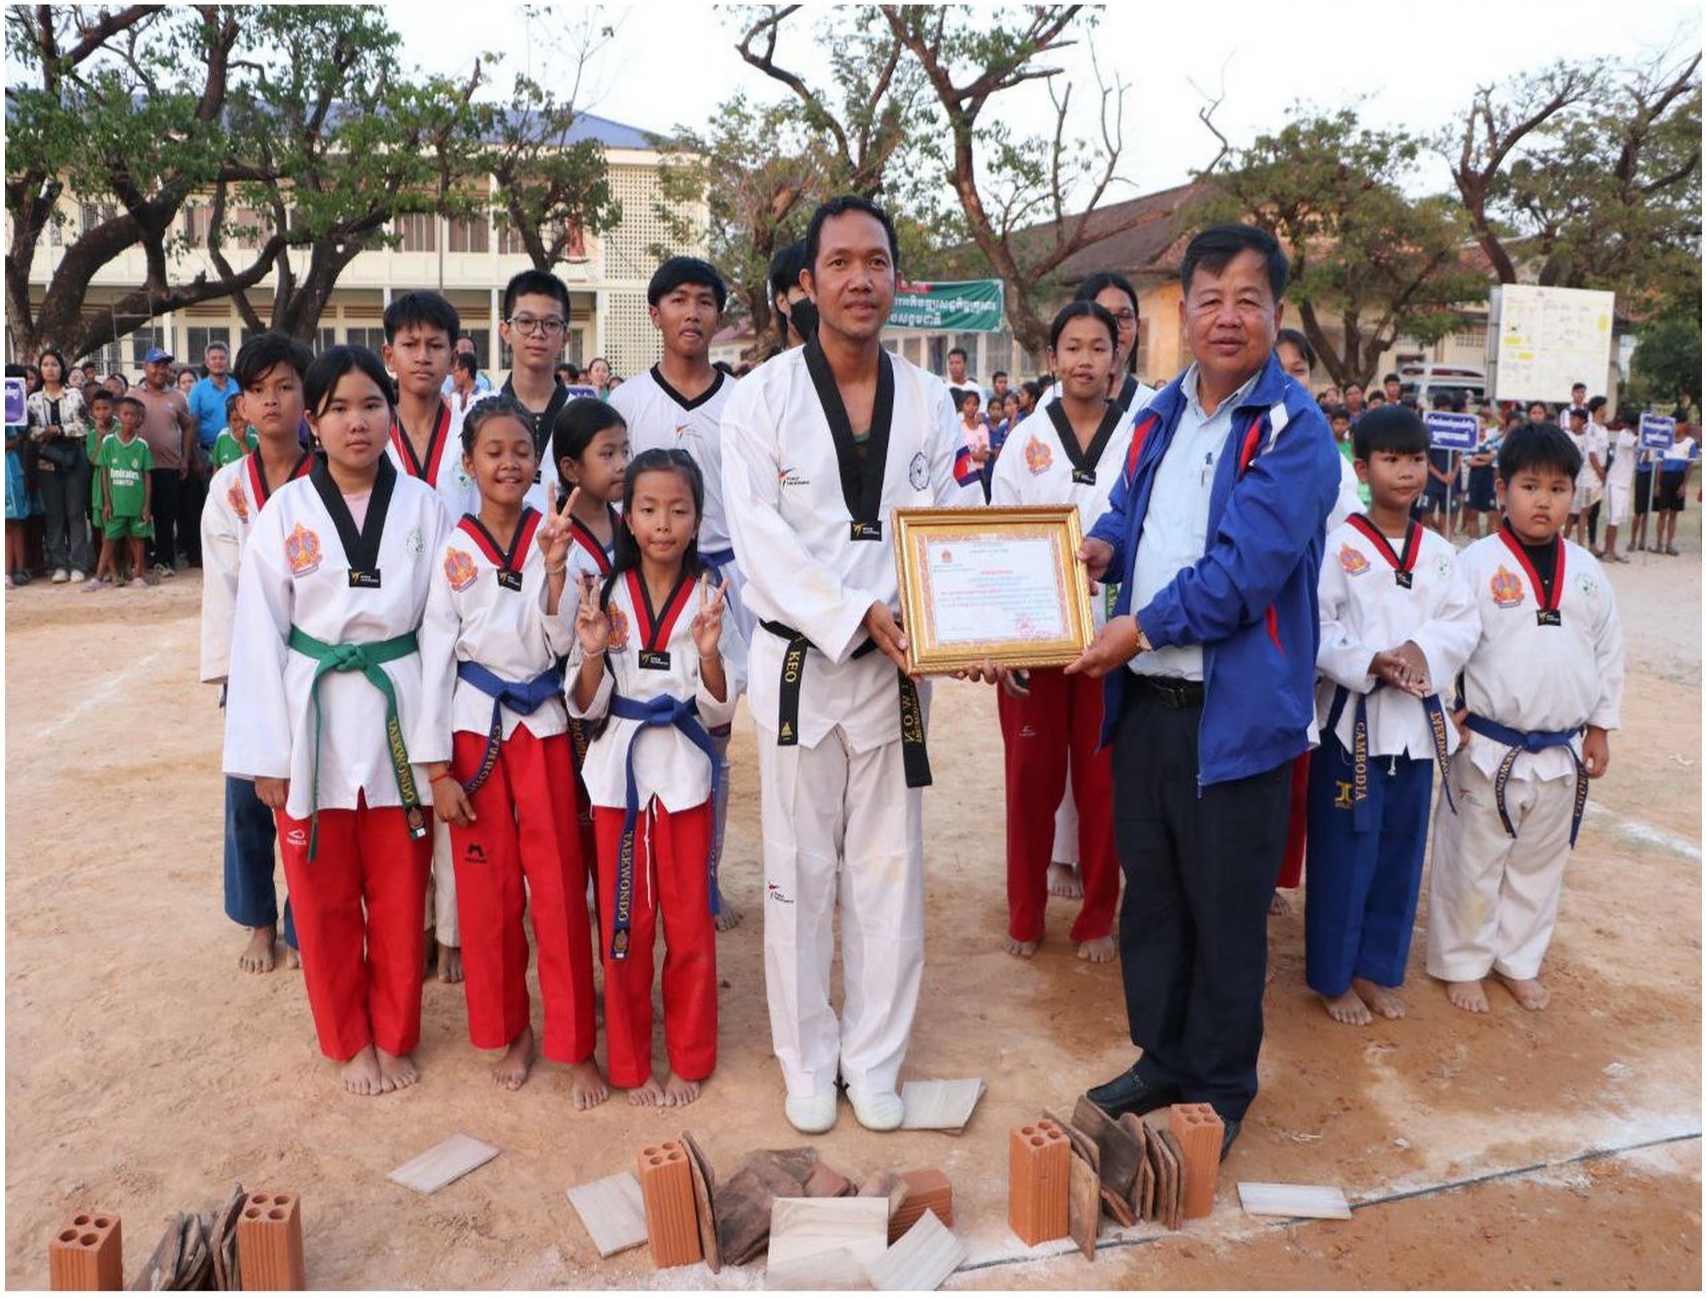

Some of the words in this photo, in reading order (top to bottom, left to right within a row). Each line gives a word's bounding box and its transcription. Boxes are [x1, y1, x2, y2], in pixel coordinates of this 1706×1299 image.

[783, 650, 801, 683] KEO
[388, 717, 415, 803] TAEKWONDO
[1354, 721, 1368, 801] CAMBODIA
[617, 830, 634, 923] TAEKWONDO
